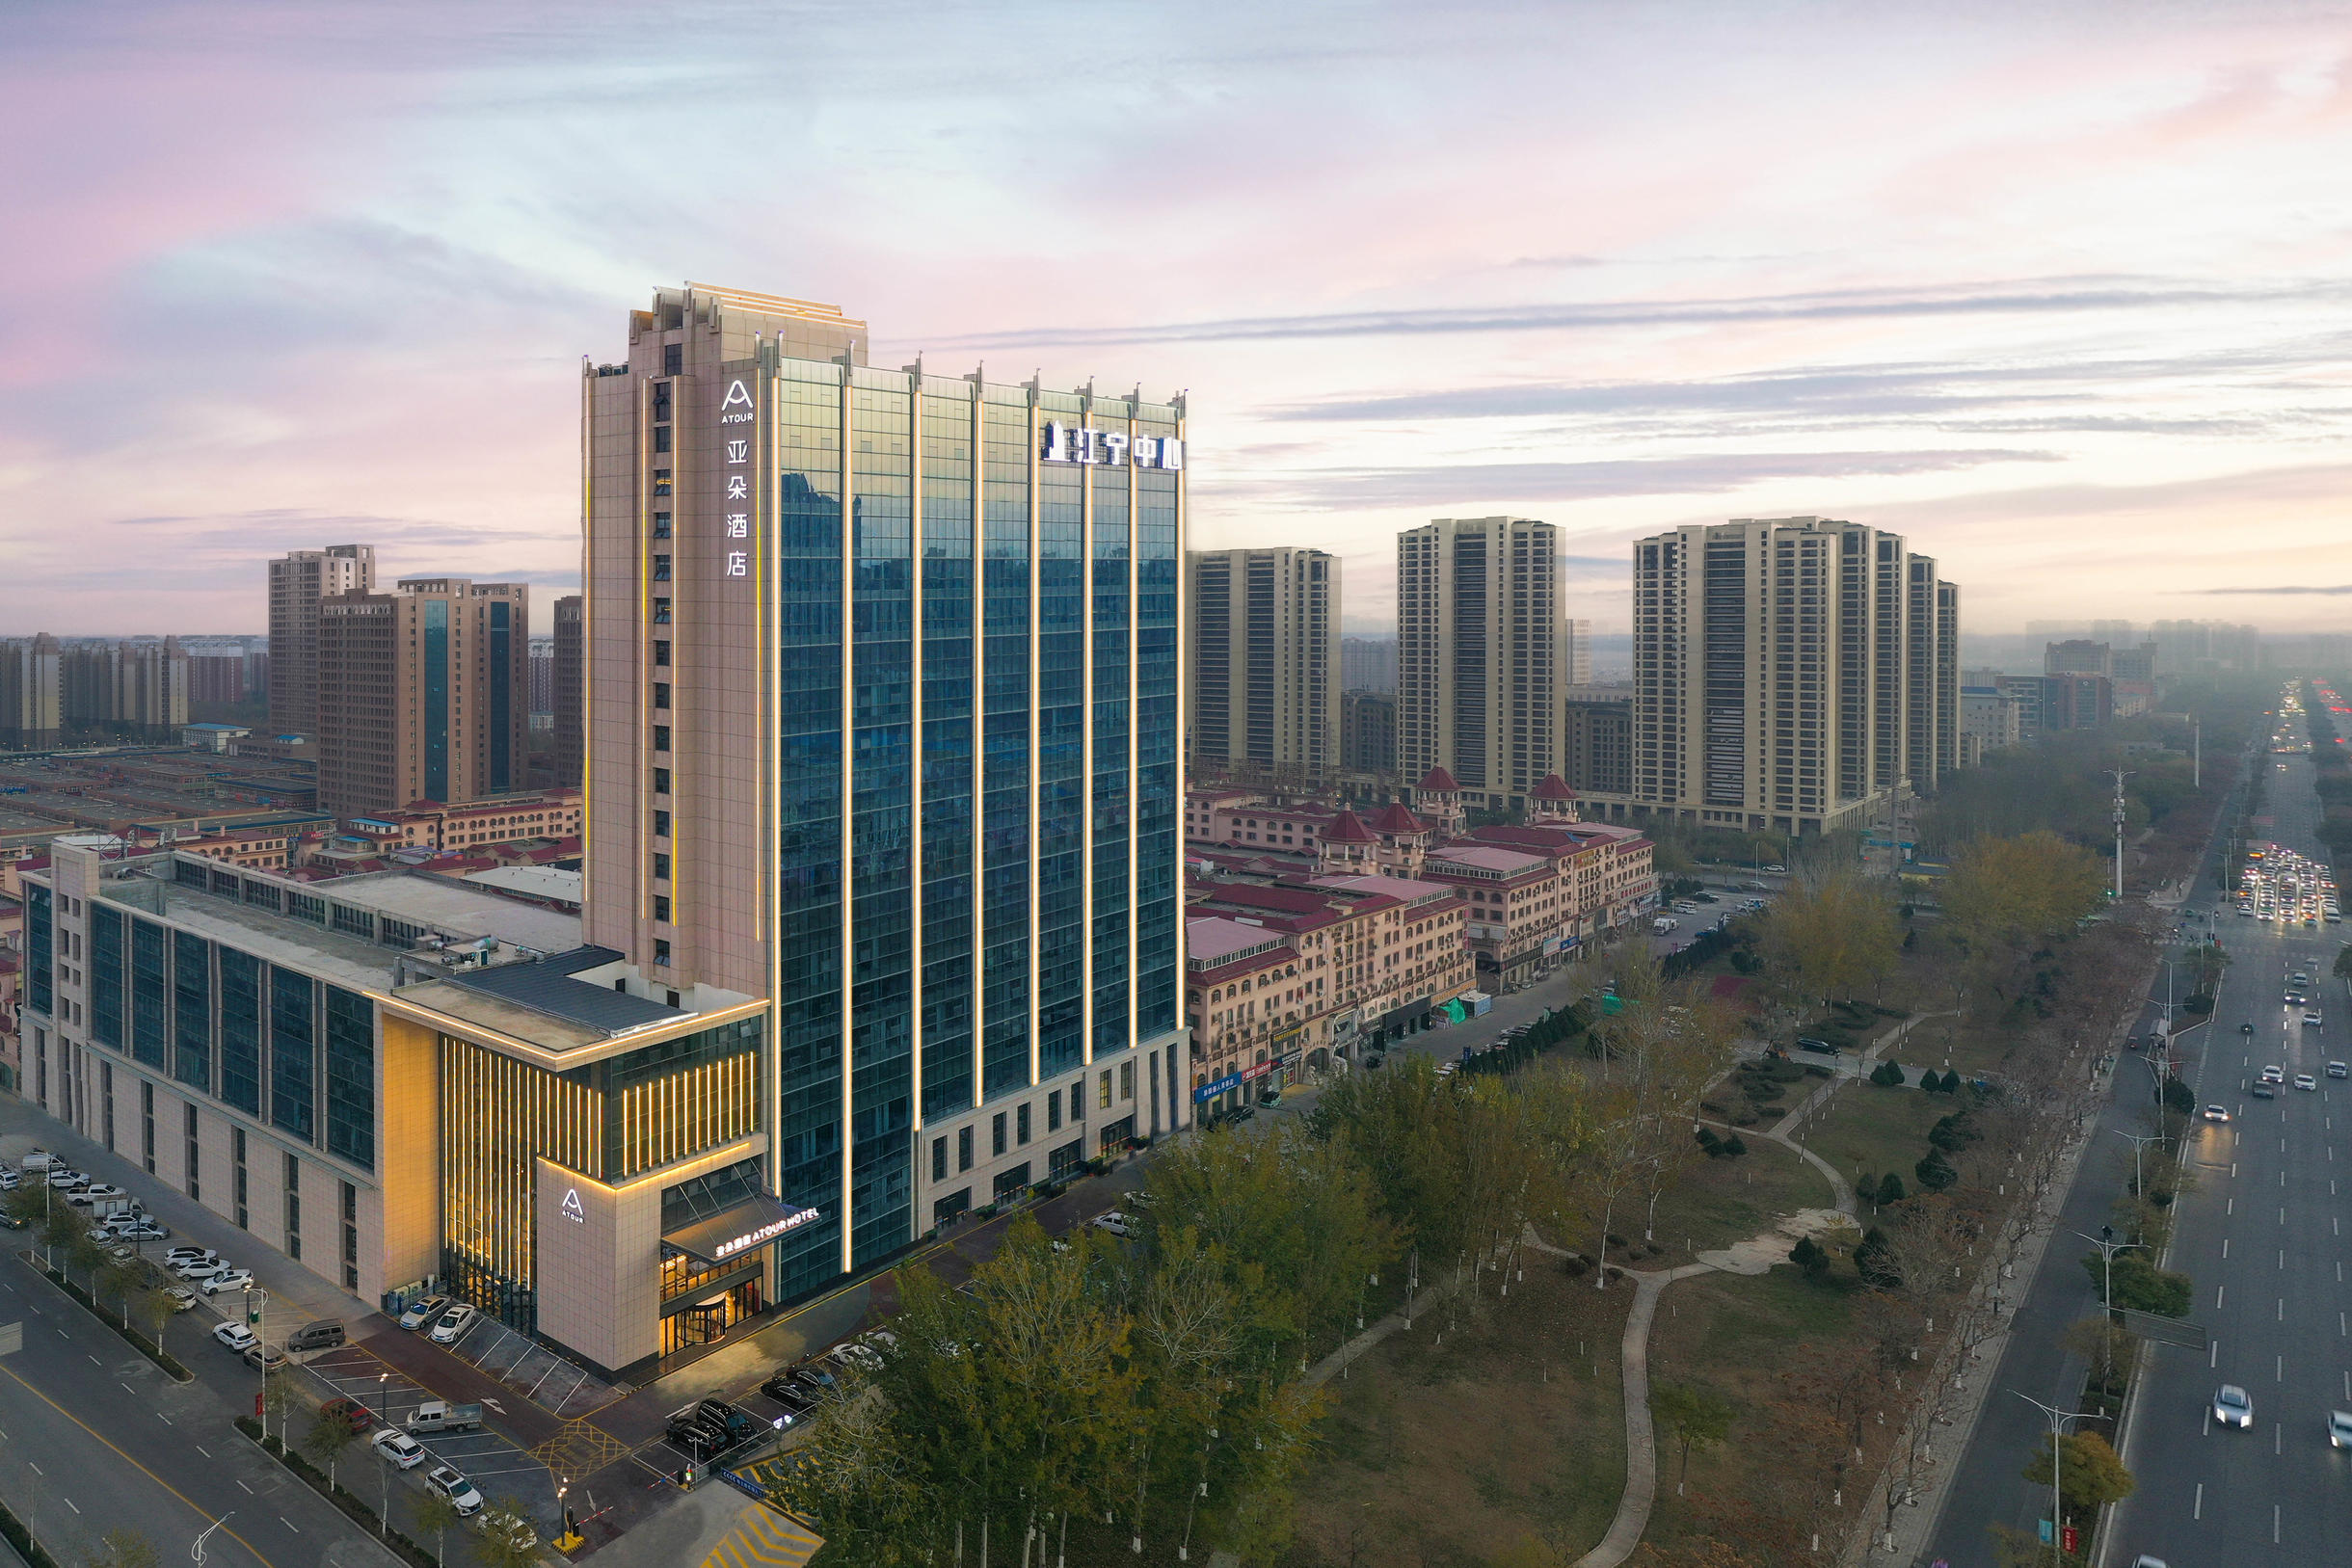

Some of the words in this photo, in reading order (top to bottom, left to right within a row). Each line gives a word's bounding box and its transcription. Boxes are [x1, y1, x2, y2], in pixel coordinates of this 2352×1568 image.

[721, 412, 754, 424] ATOUR
[727, 439, 748, 576] 亚朵酒店
[562, 1209, 583, 1224] ATOUR
[752, 1220, 786, 1241] ATOUR
[787, 1208, 819, 1228] HOTEL
